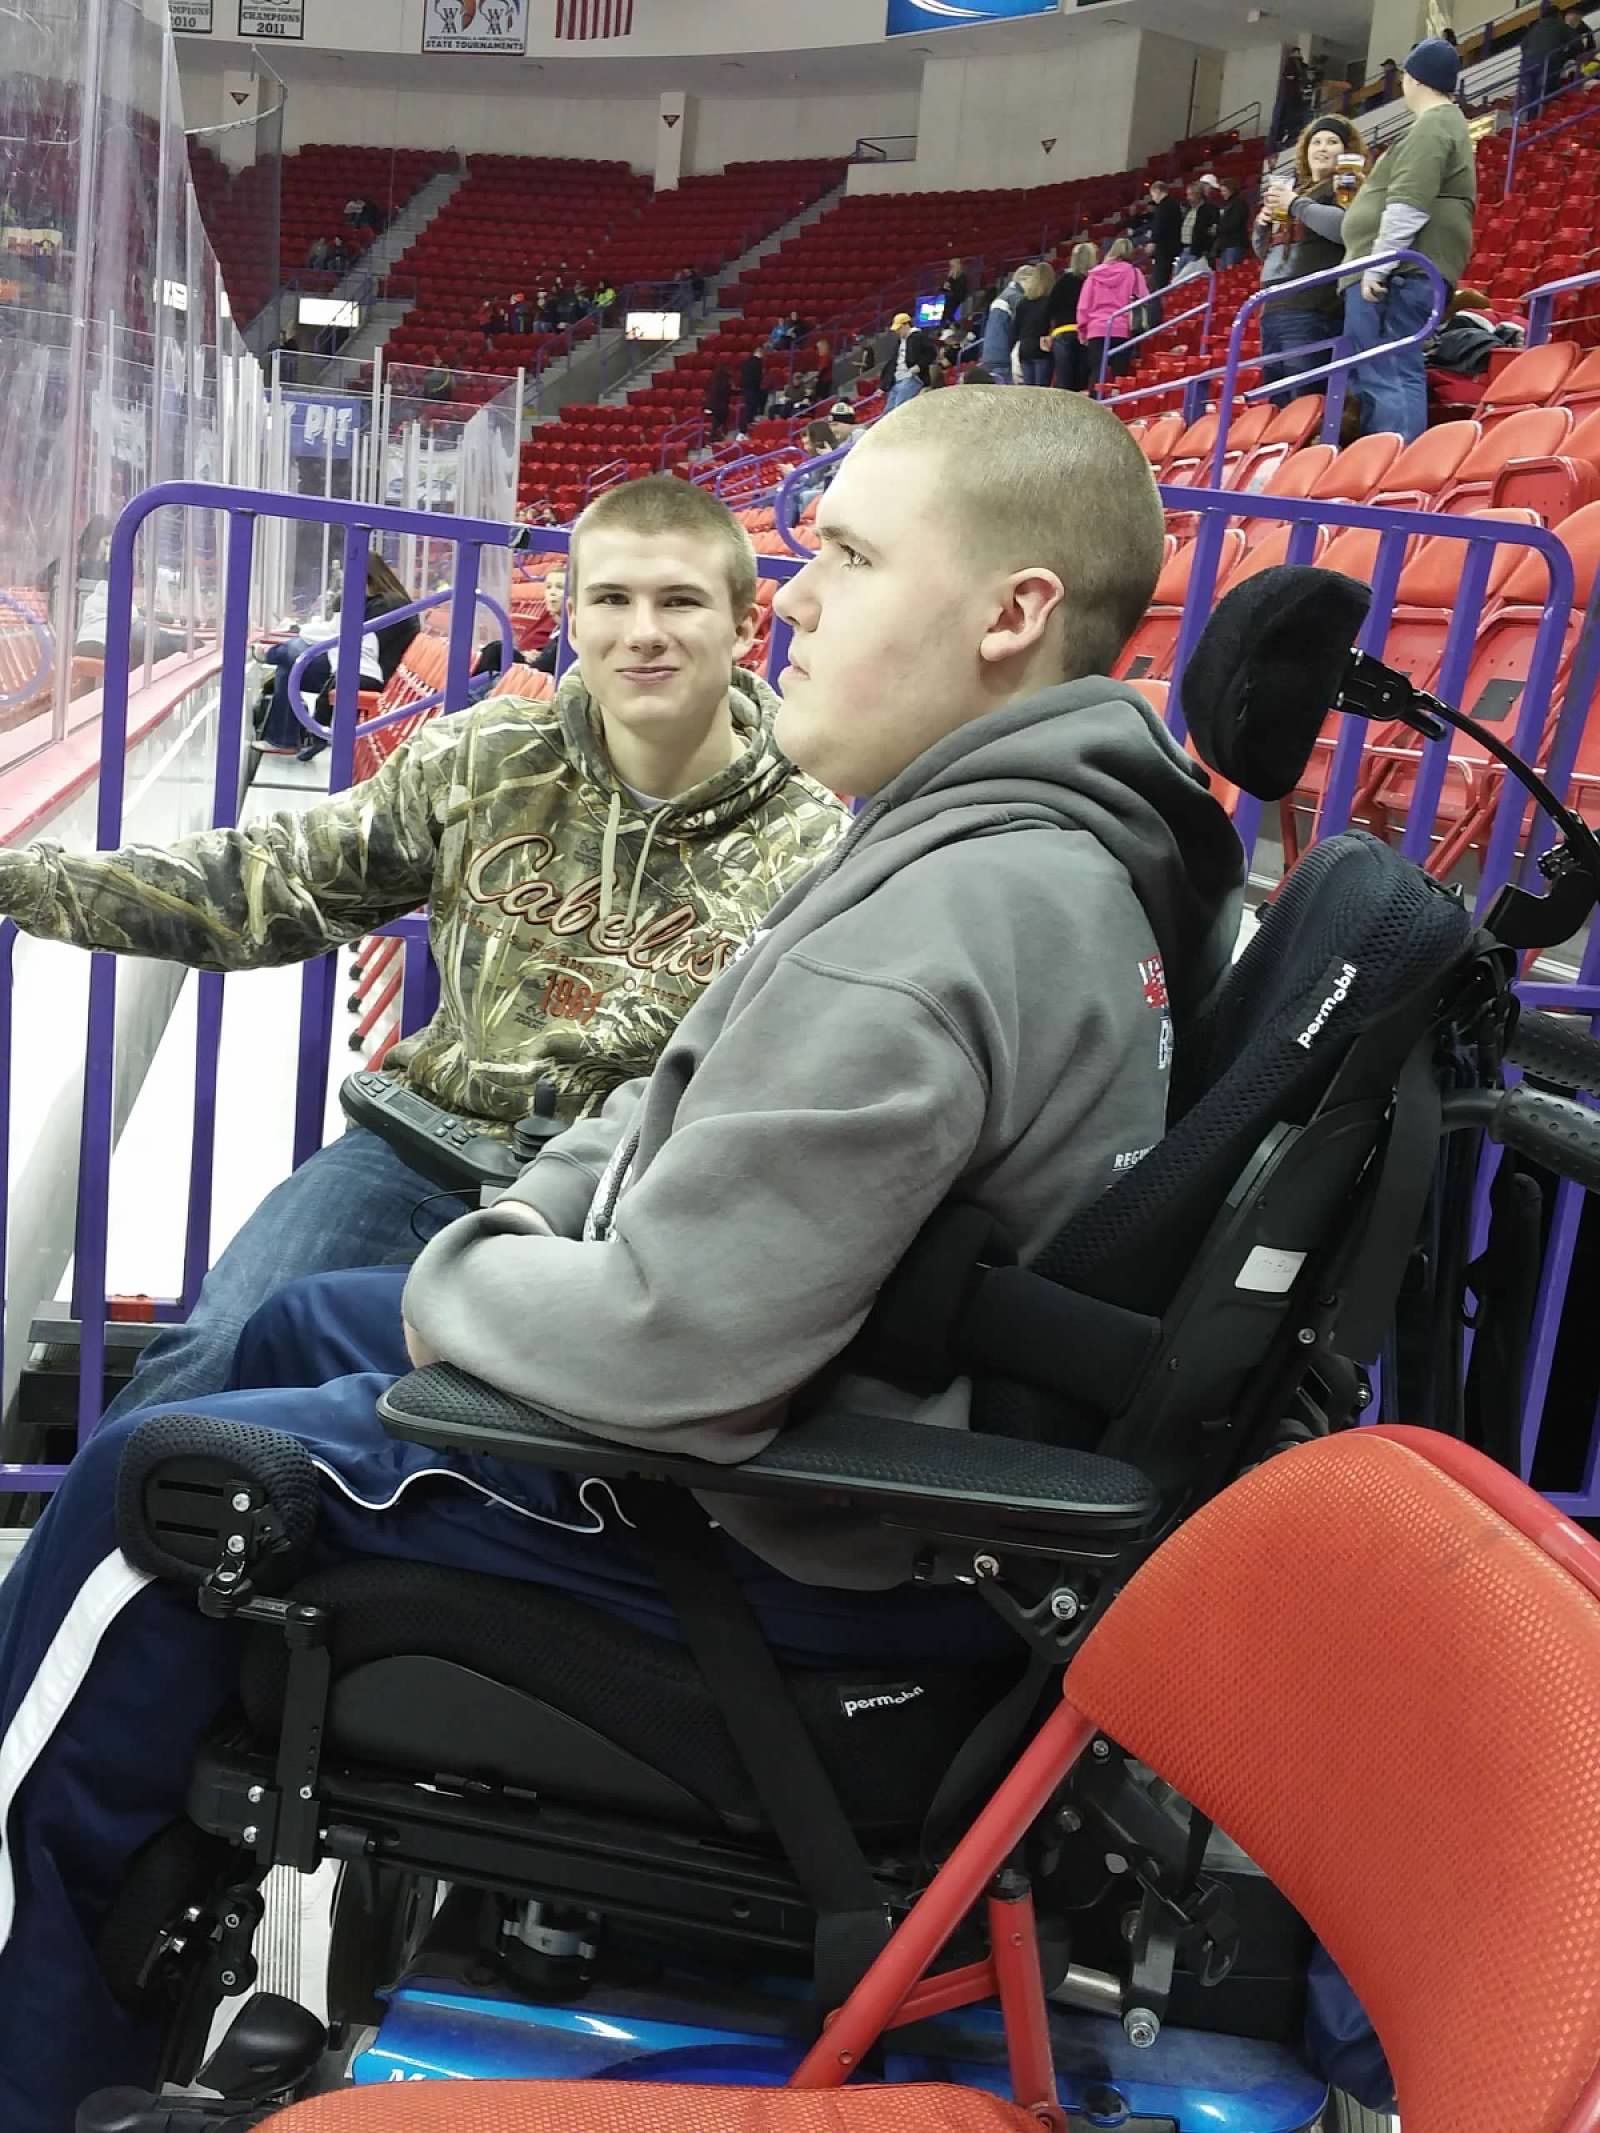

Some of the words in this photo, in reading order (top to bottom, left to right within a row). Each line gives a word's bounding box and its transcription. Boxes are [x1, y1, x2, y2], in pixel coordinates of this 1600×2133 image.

[242, 11, 300, 22] CHAMPIONS
[256, 22, 285, 34] 2011
[425, 40, 452, 48] STATE
[455, 40, 523, 50] TOURNAMENTS
[467, 833, 732, 985] Cabela's
[1297, 963, 1357, 1049] permobil
